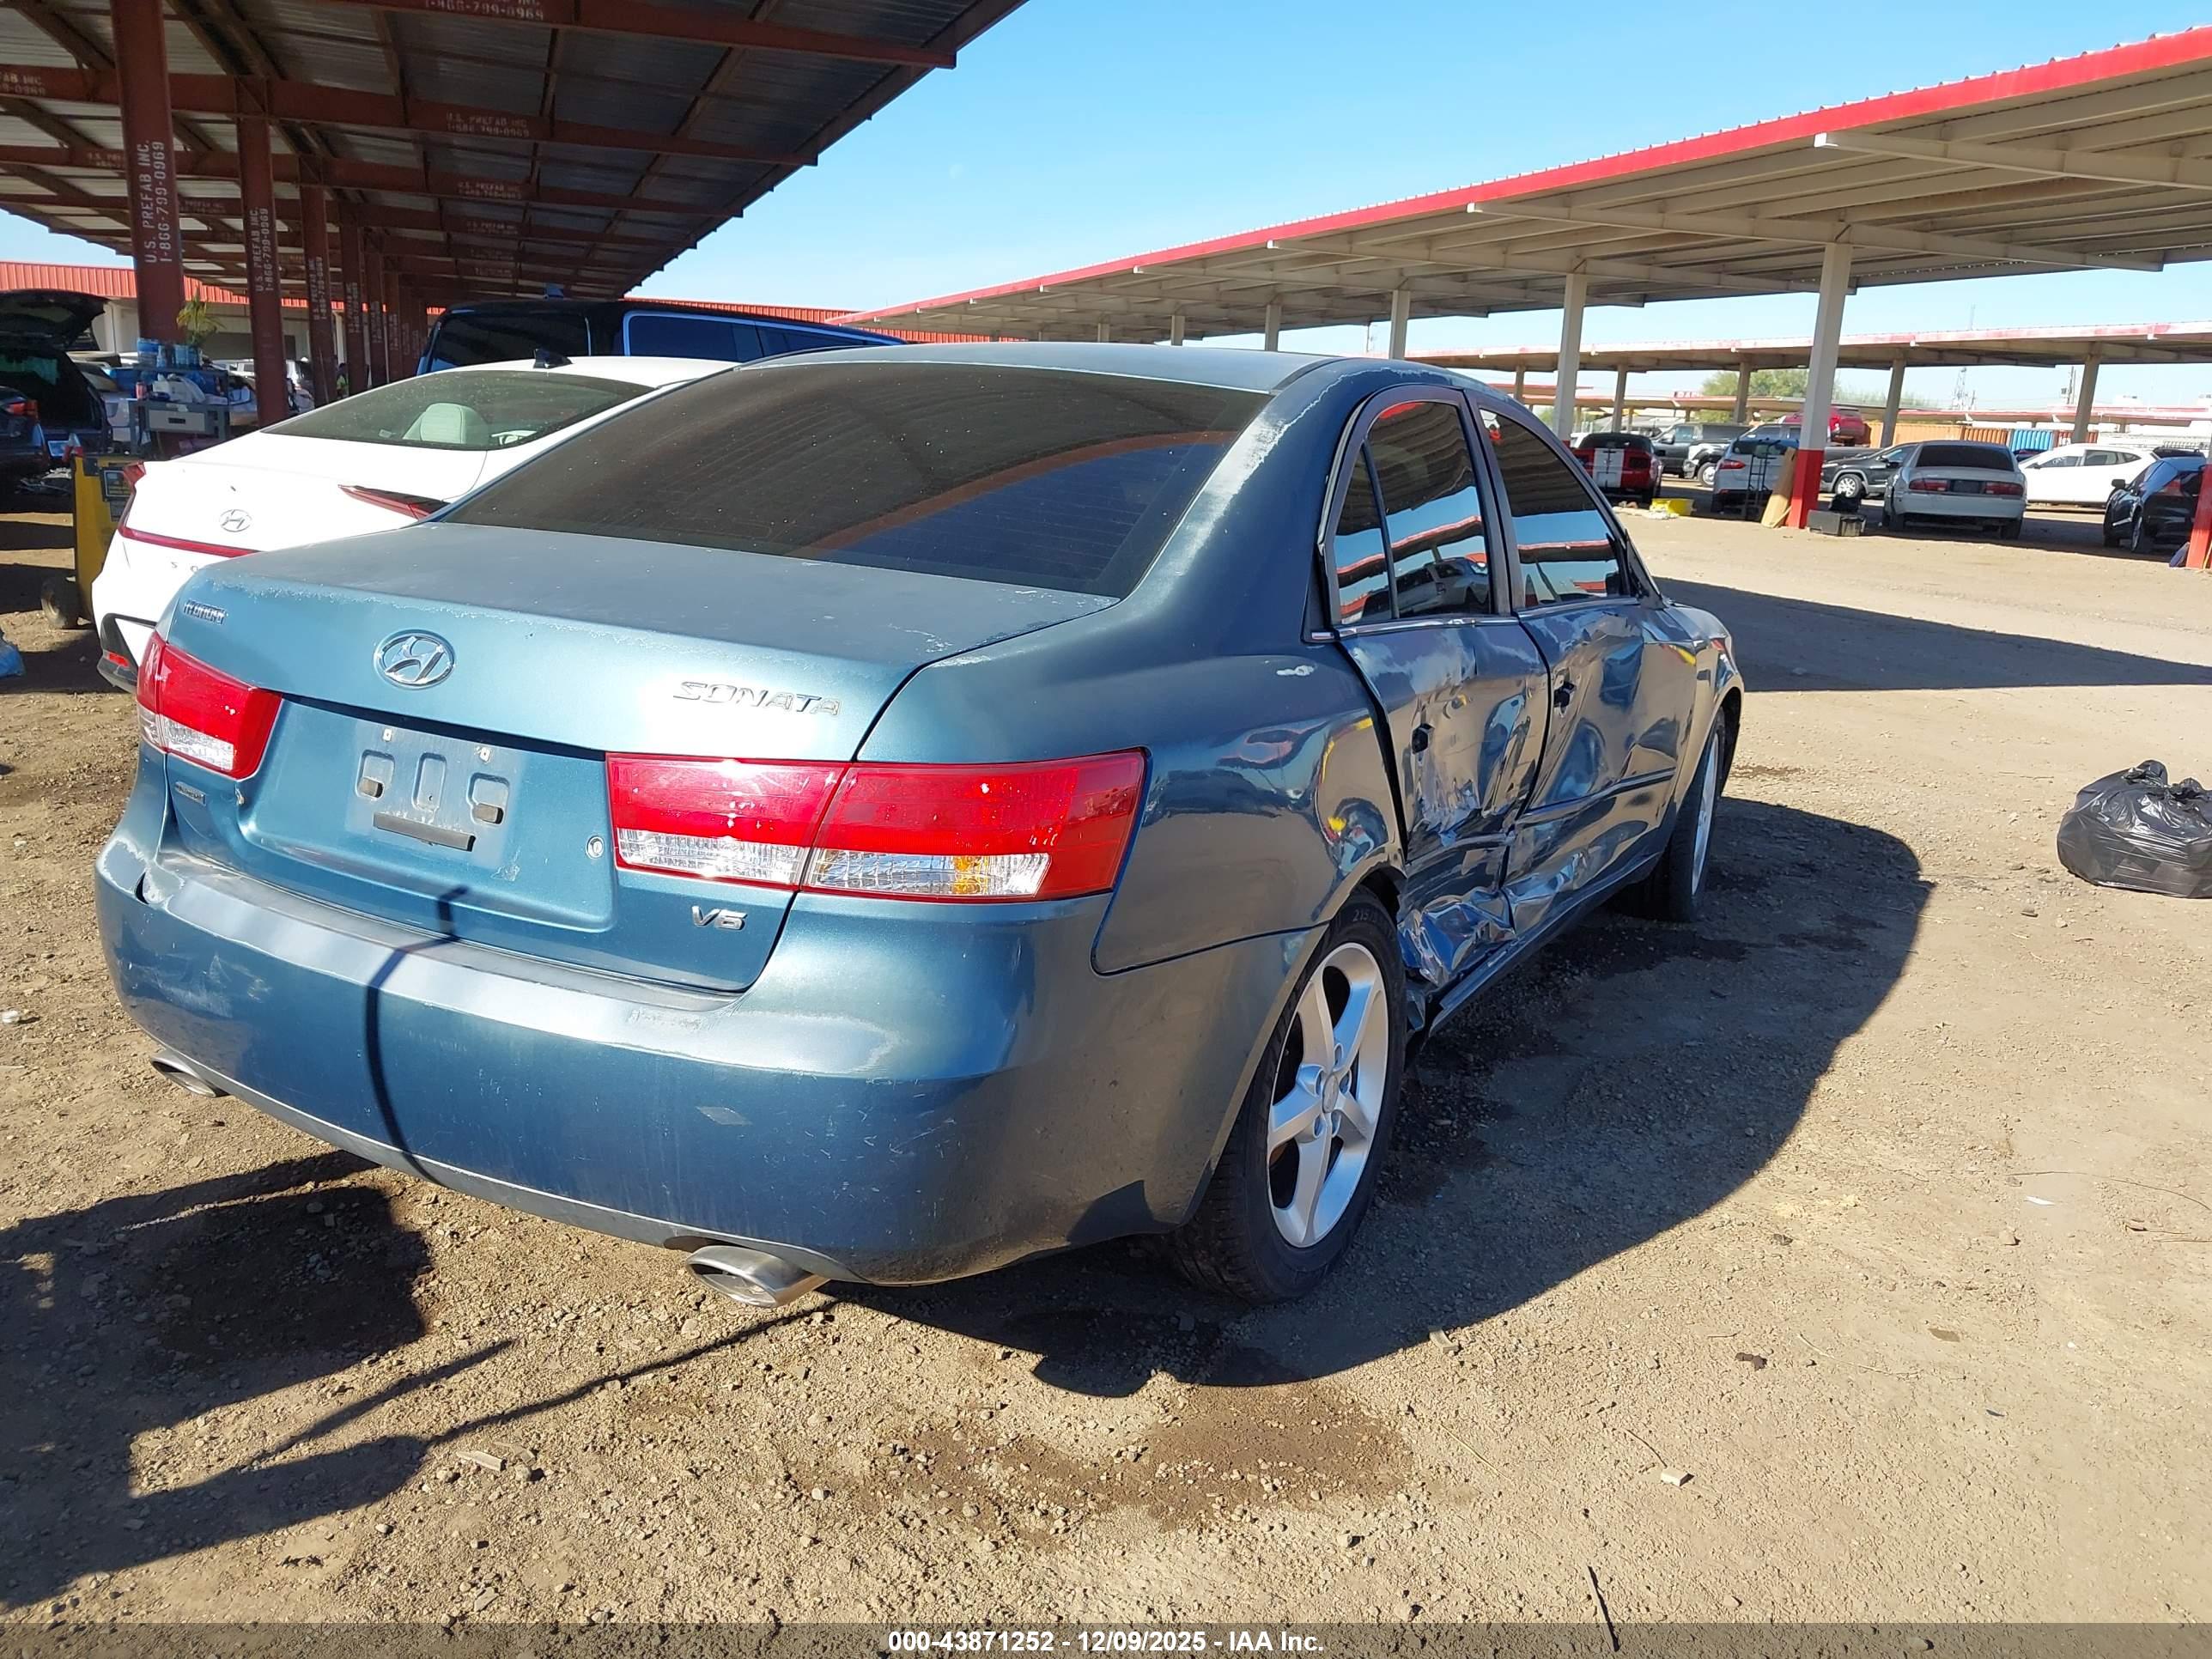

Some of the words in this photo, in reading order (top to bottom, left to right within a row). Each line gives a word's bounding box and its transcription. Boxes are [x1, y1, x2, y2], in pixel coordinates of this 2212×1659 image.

[137, 140, 151, 166] INC.
[138, 173, 155, 228] PREFAB
[152, 141, 172, 262] 1-866-799-0969
[143, 236, 158, 263] U.S.
[250, 230, 262, 268] PREFAB
[672, 681, 842, 715] SONATA
[691, 905, 748, 931] V6
